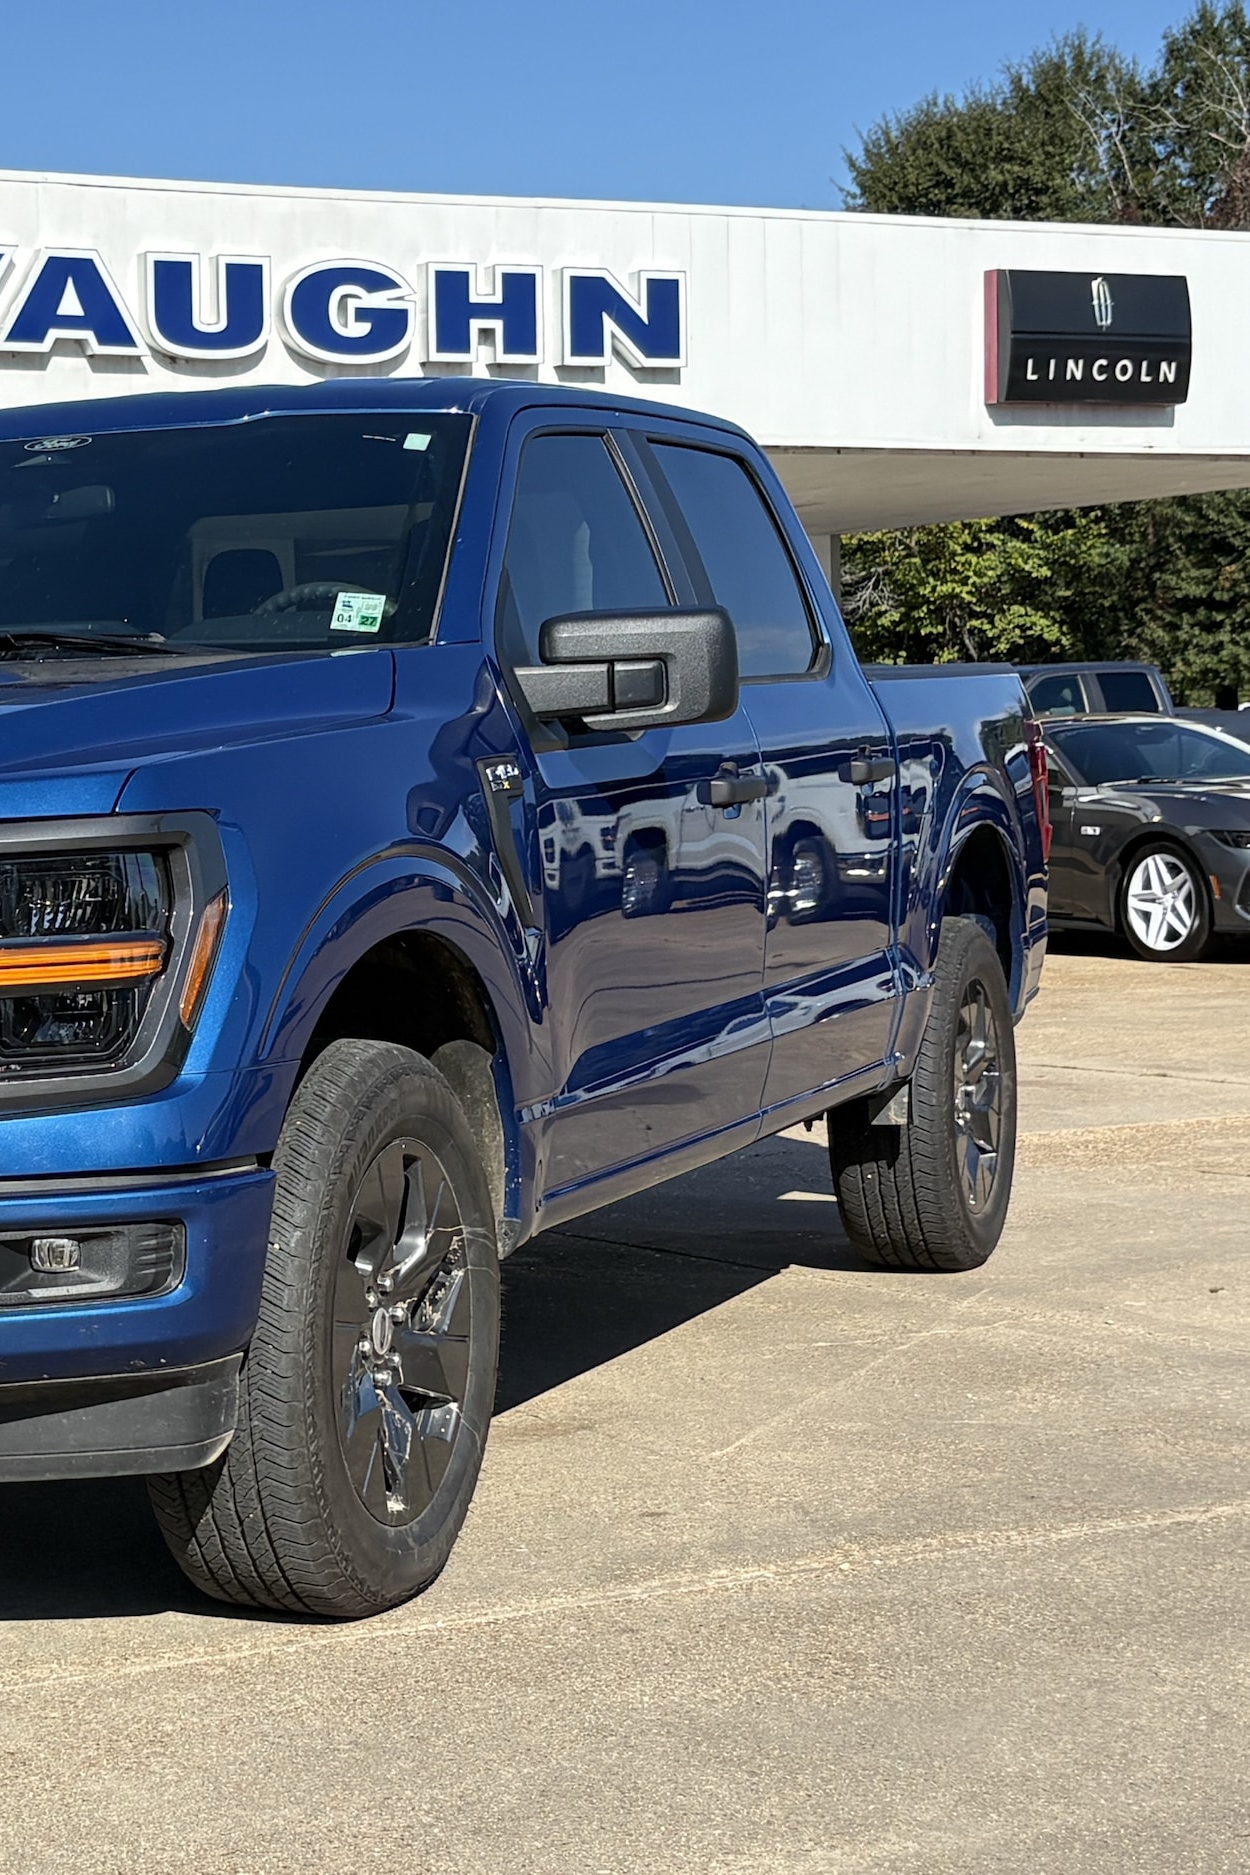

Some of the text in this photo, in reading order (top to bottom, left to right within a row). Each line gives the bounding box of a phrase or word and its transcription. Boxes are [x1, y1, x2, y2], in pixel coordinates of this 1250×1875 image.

[1025, 358, 1177, 383] LINCOLN
[337, 613, 352, 624] 04
[358, 614, 378, 627] 27
